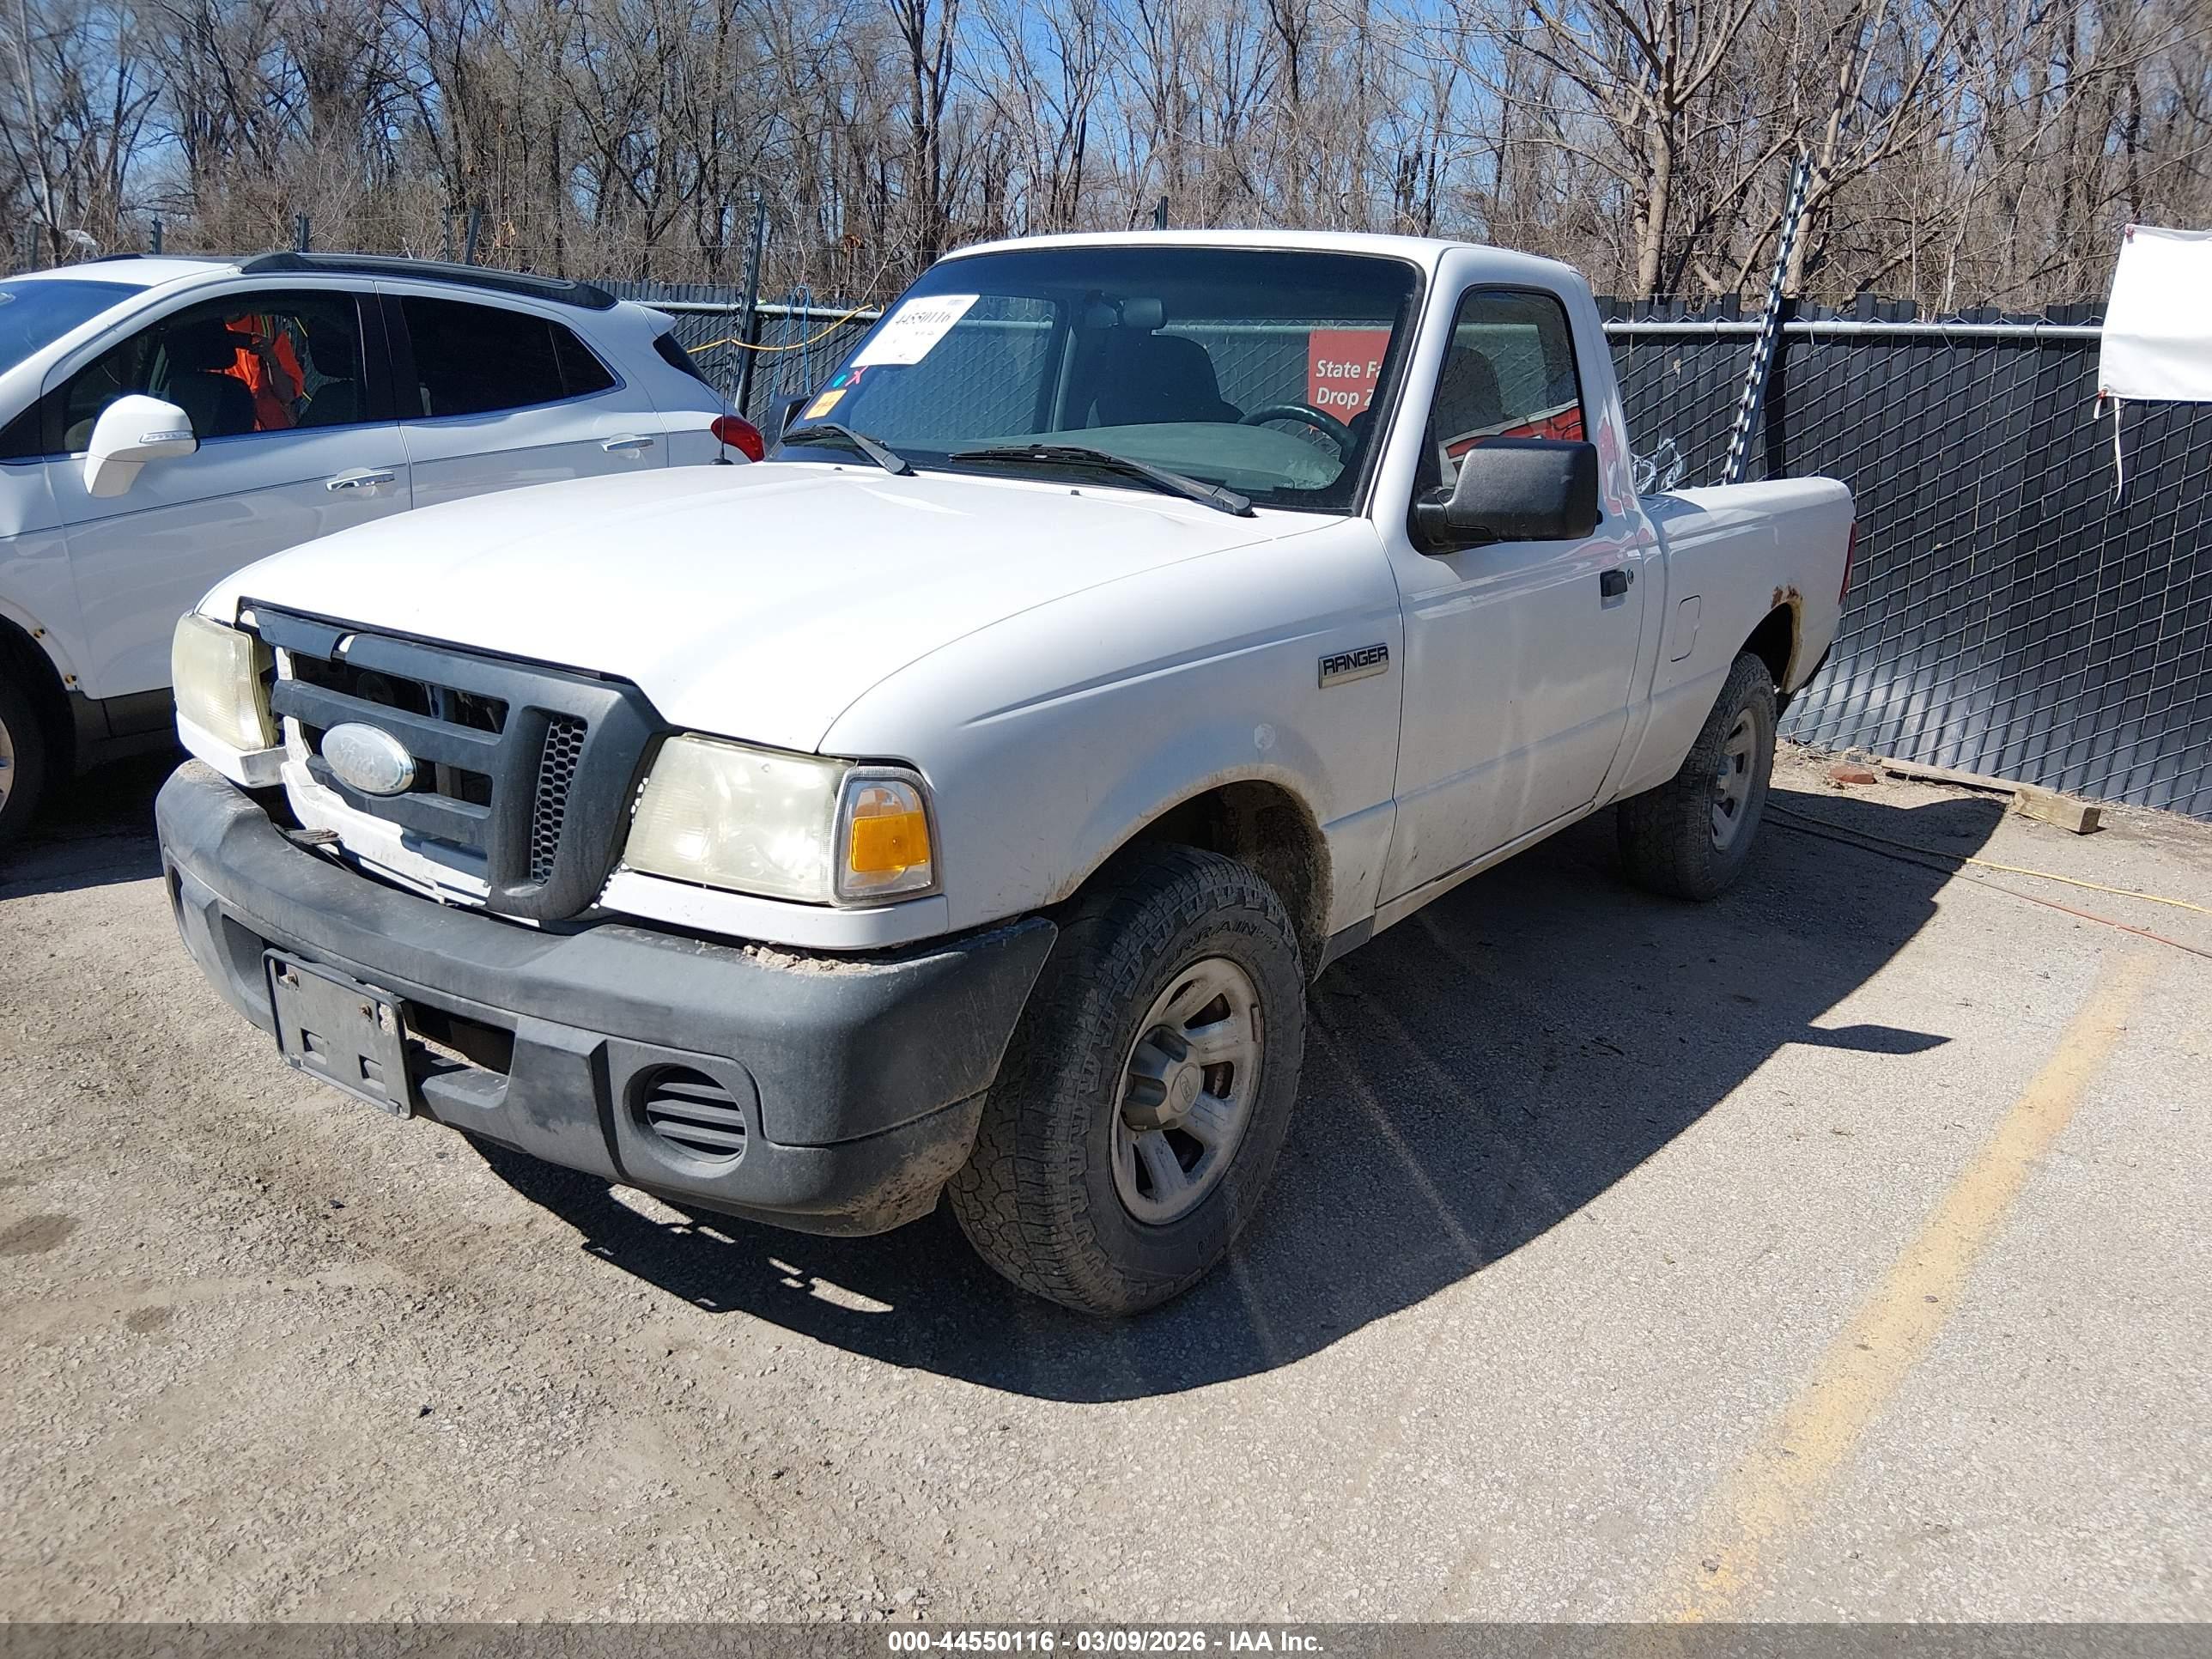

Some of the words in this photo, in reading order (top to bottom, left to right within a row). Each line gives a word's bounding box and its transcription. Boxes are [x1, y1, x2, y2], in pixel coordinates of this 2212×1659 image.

[1316, 359, 1361, 379] State
[1316, 386, 1359, 410] Drop
[1322, 646, 1389, 676] RANGER
